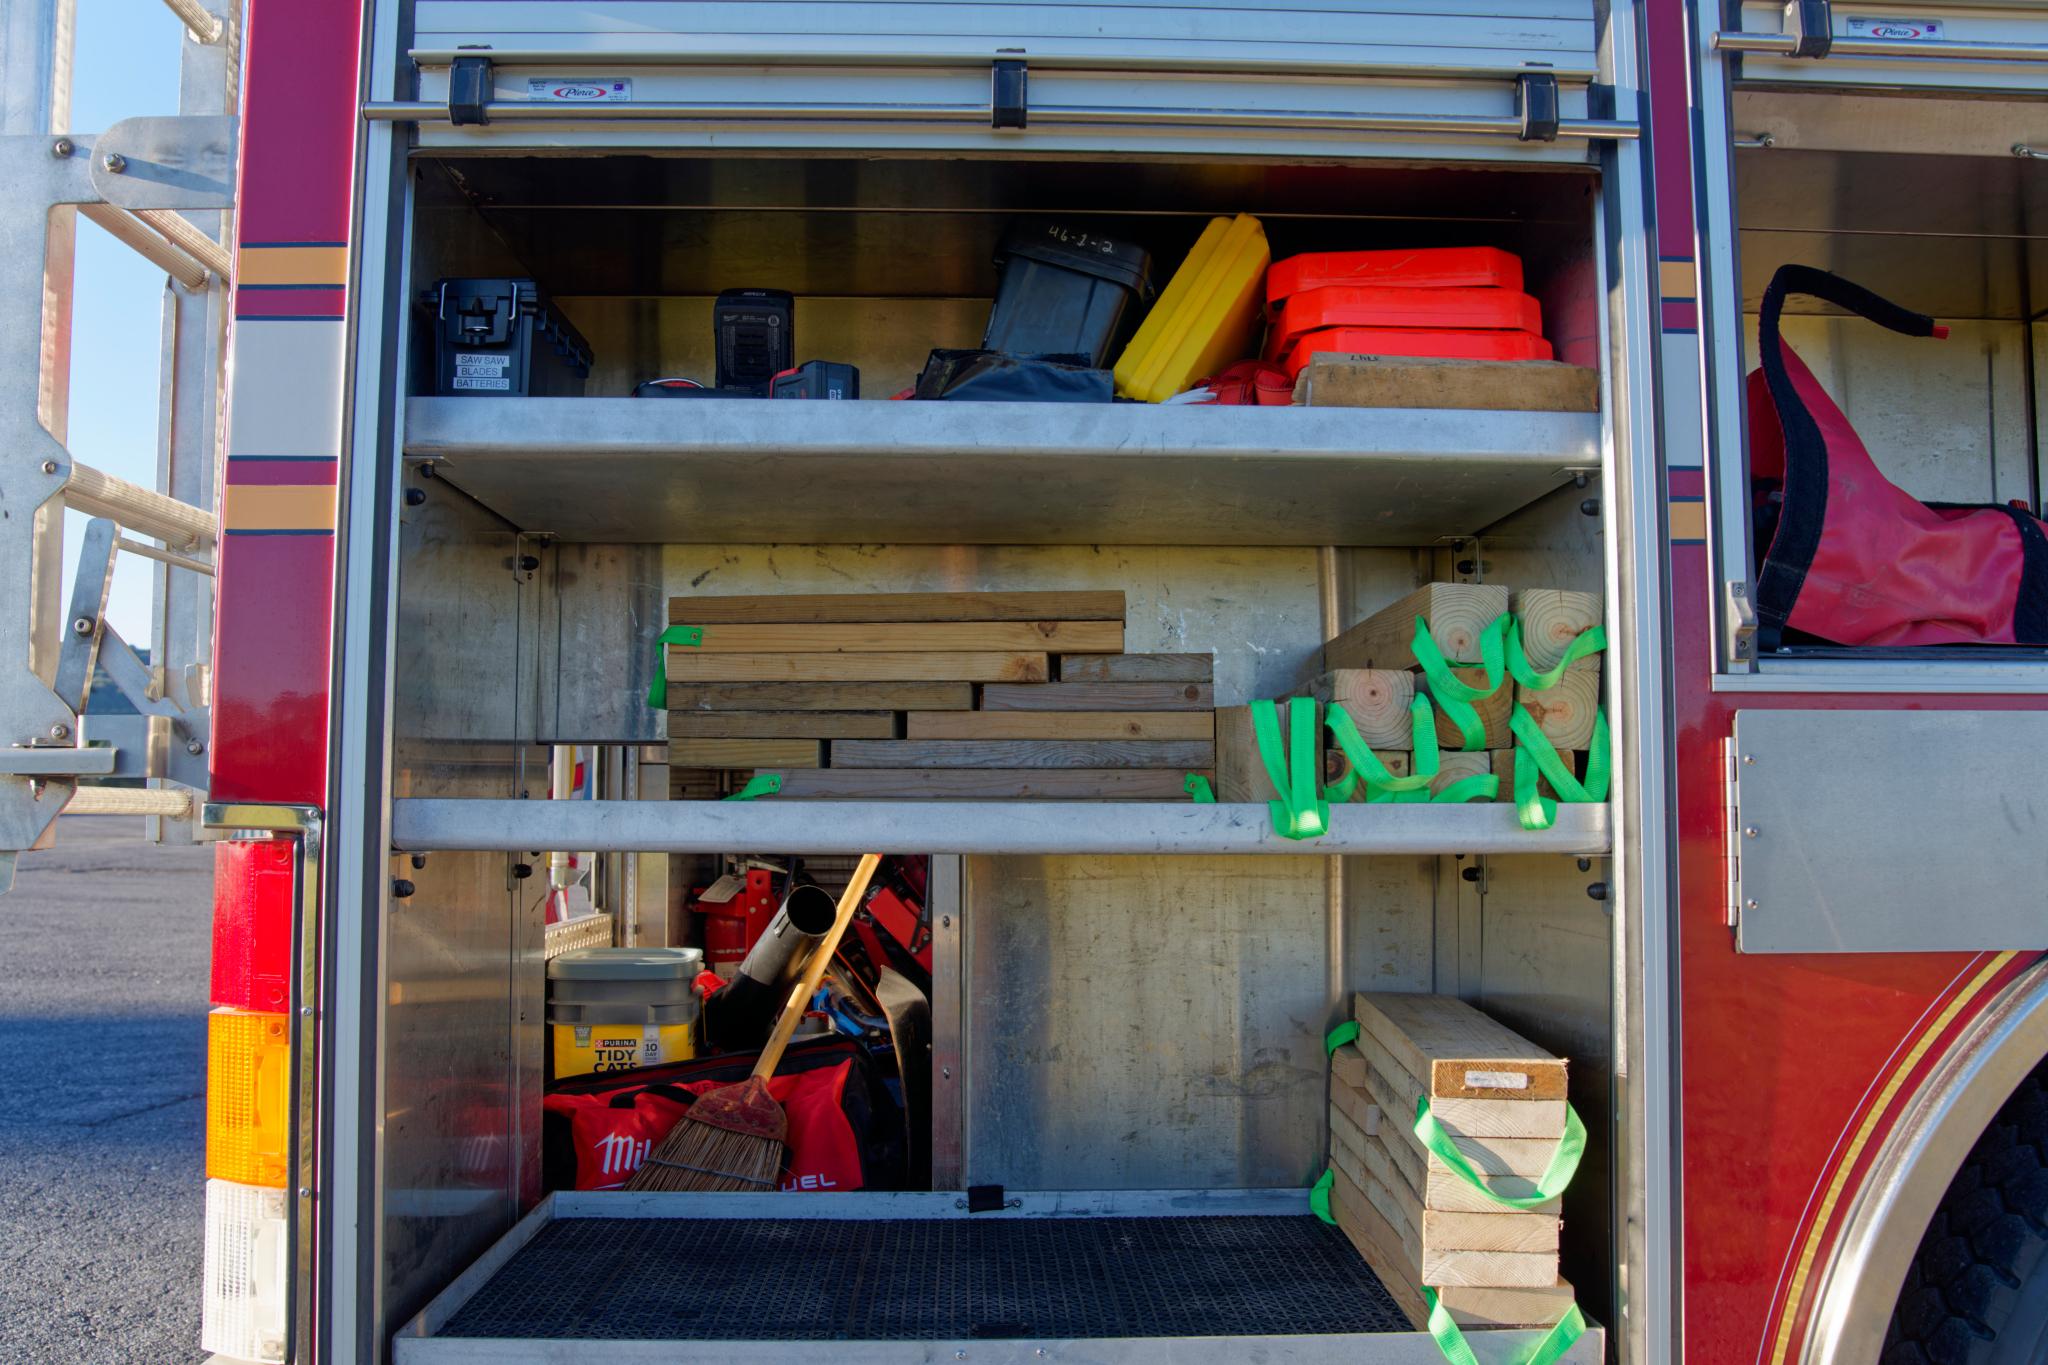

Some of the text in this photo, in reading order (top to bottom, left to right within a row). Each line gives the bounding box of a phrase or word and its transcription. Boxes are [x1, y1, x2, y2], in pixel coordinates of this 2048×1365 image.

[1882, 27, 1909, 37] Pierce
[565, 87, 594, 97] Pierce
[461, 356, 506, 365] SAW SAW
[461, 367, 498, 376] BLADES
[456, 379, 508, 388] BATTERIES
[646, 1043, 658, 1052] 10
[595, 1050, 636, 1061] TIDY
[780, 1173, 837, 1192] UEL
